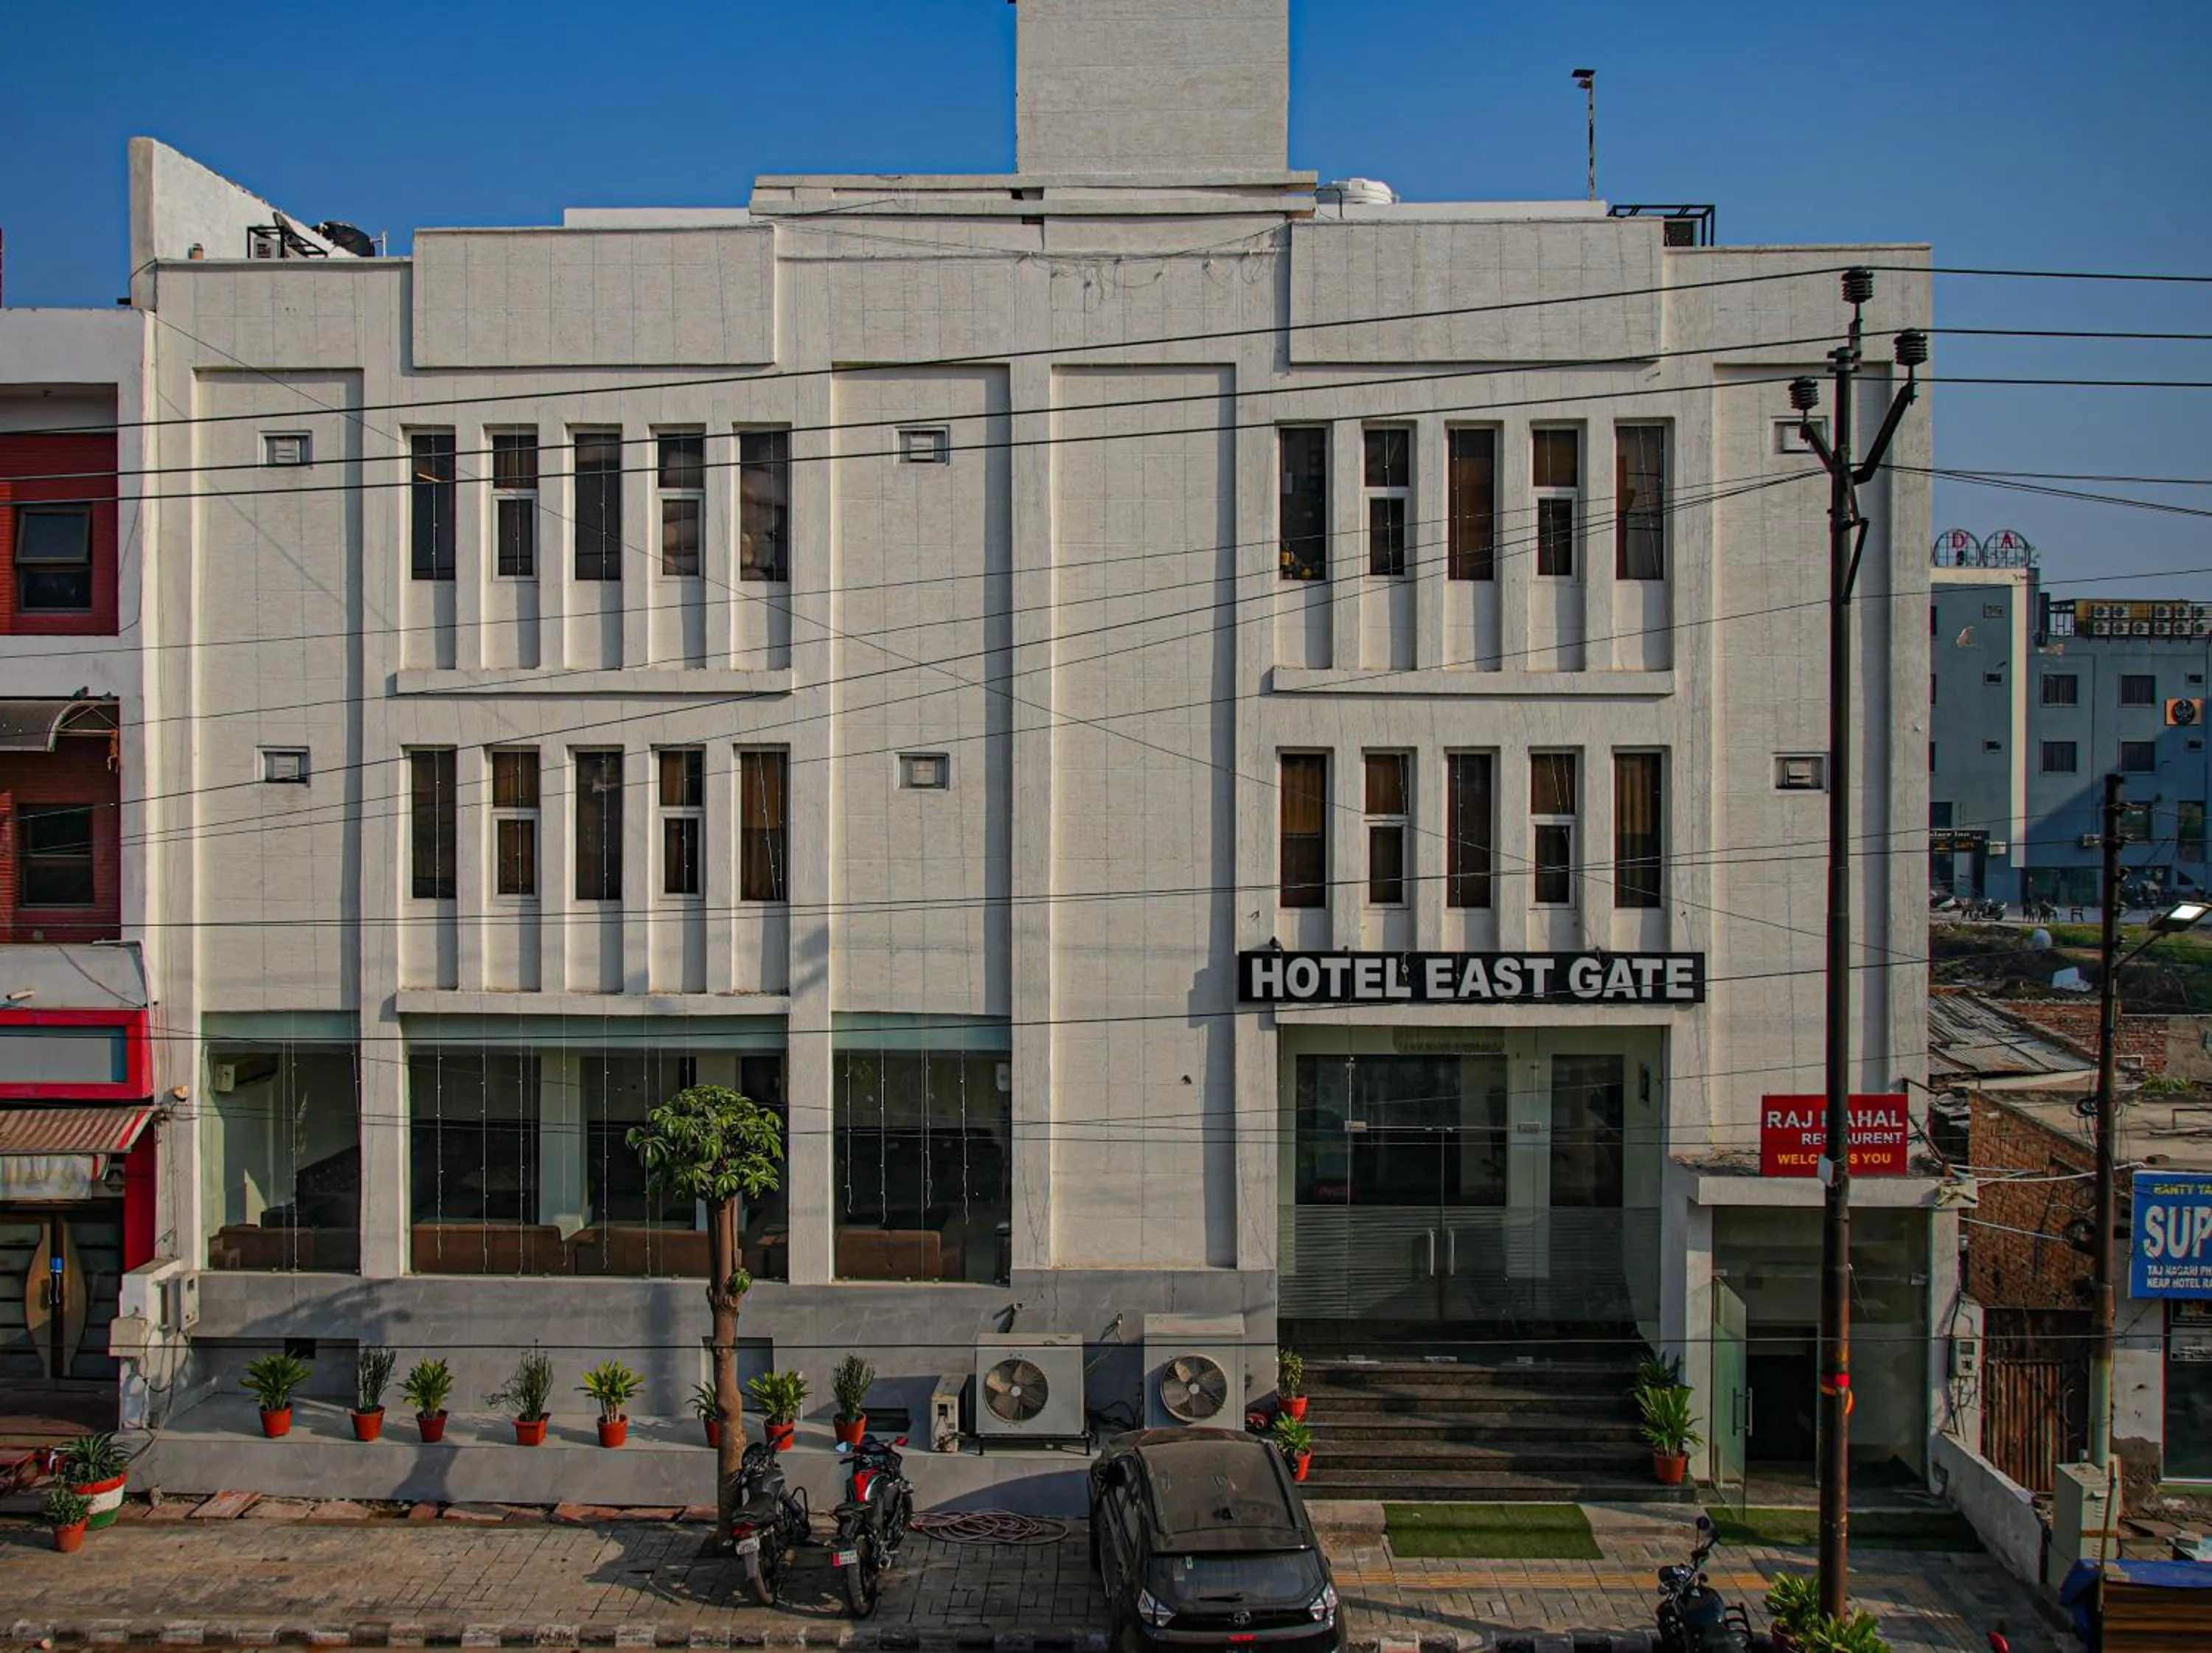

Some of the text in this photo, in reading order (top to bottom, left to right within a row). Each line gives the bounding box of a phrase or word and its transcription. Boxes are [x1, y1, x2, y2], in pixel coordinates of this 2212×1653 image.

[1251, 956, 1694, 999] HOTEL EAST GATE
[1767, 1110, 1903, 1129] RAJ AHAL
[1777, 1152, 1891, 1165] WELCS YOU
[2143, 1205, 2212, 1259] SUP
[2172, 1278, 2200, 1289] HOTEL
